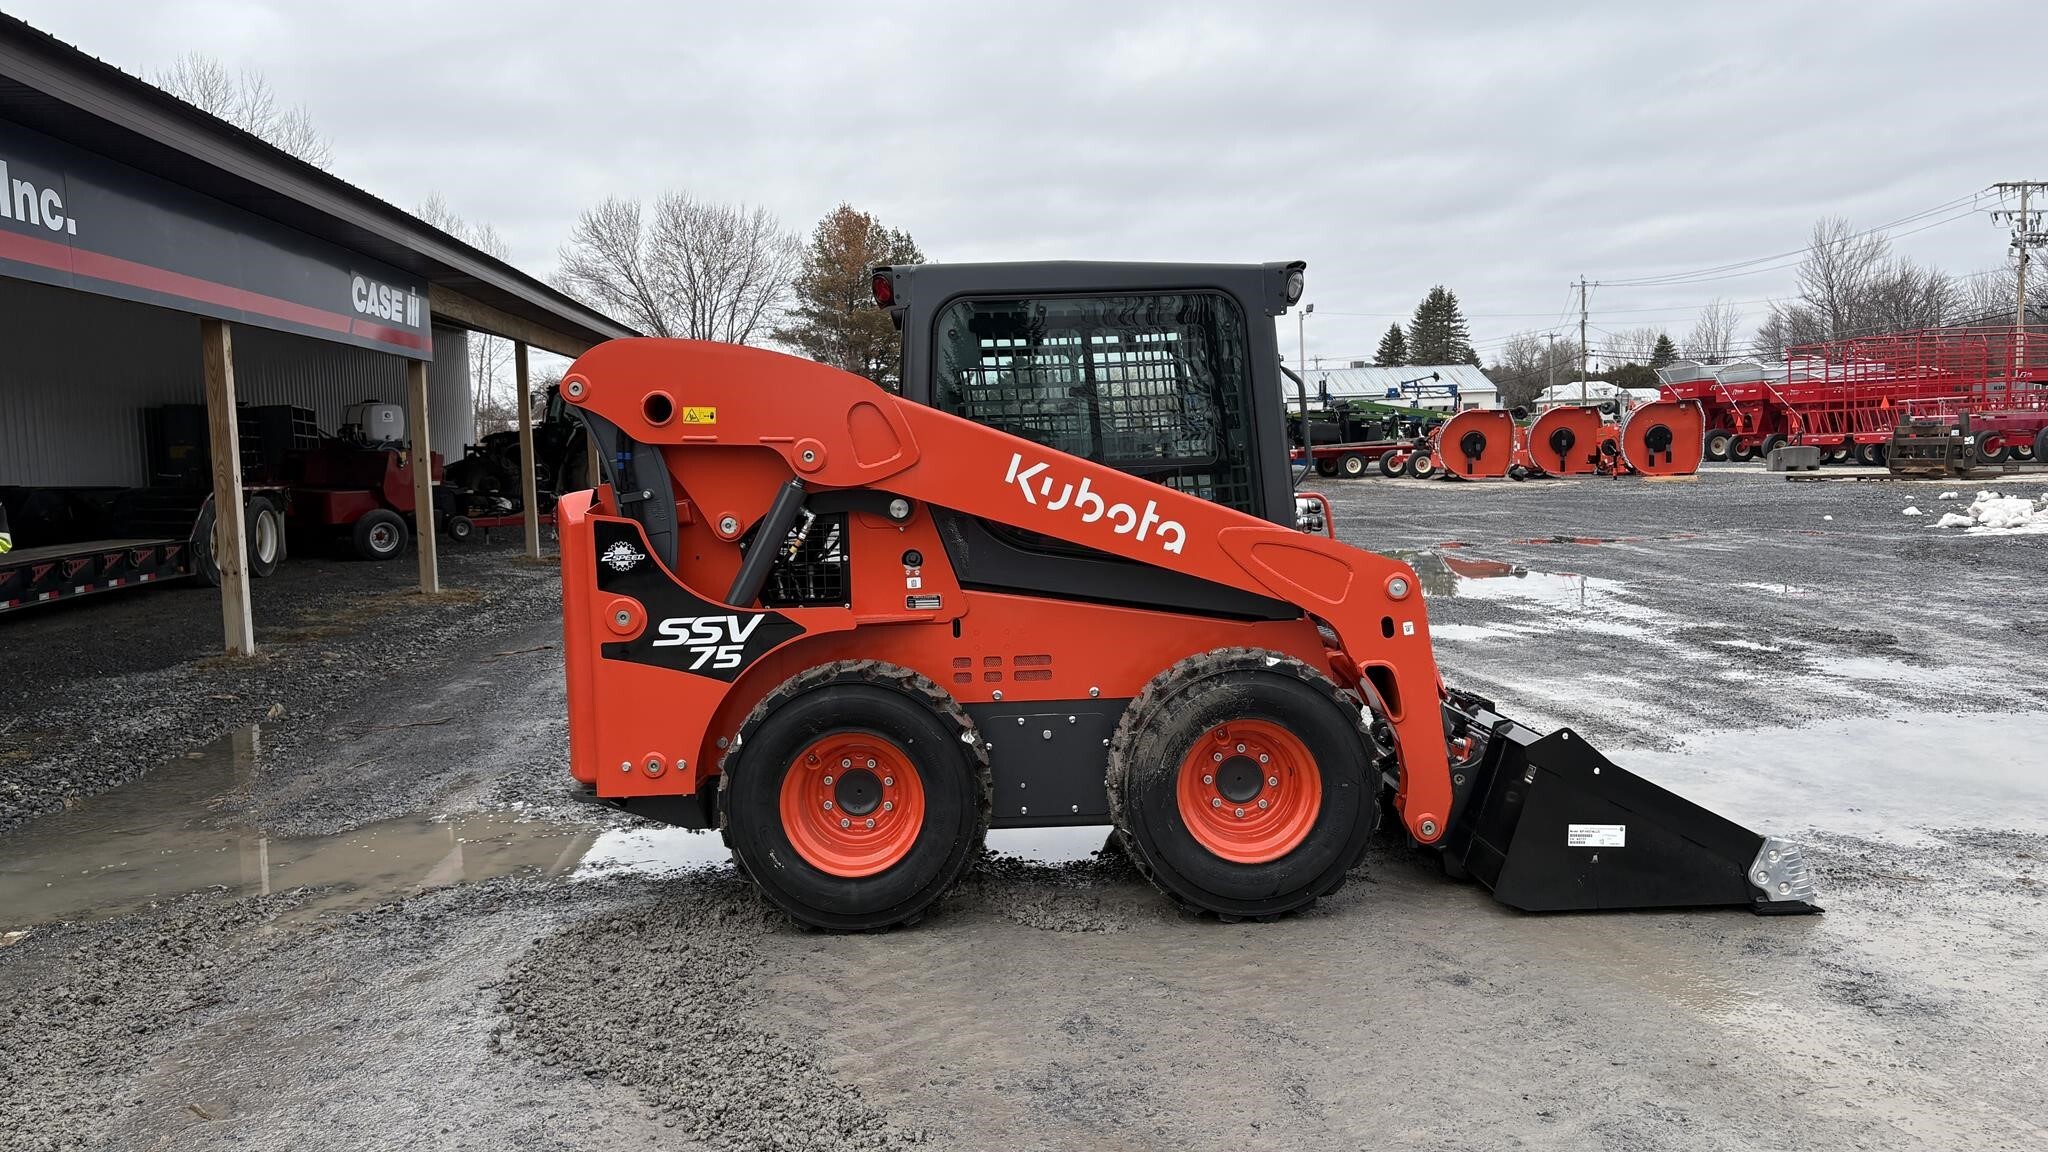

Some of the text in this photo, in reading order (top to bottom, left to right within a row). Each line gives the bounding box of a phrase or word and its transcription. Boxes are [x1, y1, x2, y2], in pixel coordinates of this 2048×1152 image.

[0, 159, 77, 236] Inc.
[352, 276, 403, 323] CASE
[1004, 453, 1186, 554] Kubota
[652, 614, 765, 647] SSV
[689, 644, 744, 670] 75
